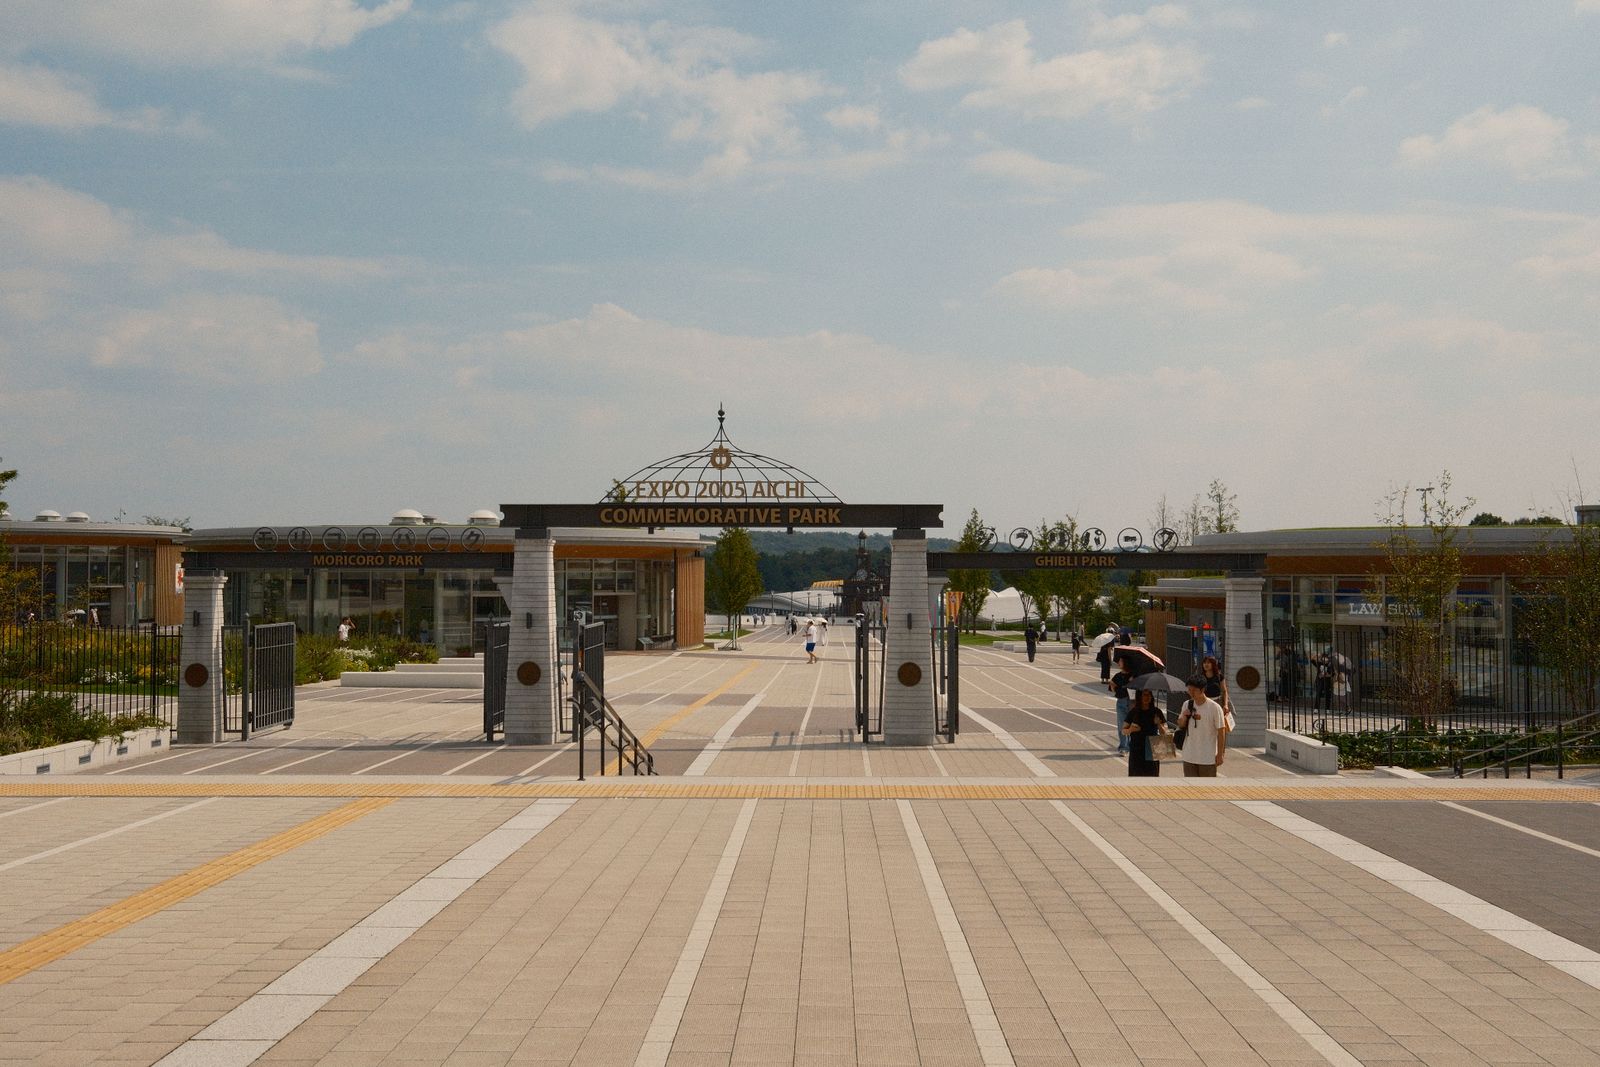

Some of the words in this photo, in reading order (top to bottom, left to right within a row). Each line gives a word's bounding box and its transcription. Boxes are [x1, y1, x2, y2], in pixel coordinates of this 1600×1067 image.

[636, 481, 690, 499] EXPO
[697, 481, 745, 499] 2005
[752, 481, 805, 499] AICHI
[600, 507, 782, 525] COMMEMORATIVE
[788, 507, 841, 525] PARK
[313, 555, 385, 566] MORICORO
[389, 555, 423, 566] PARK
[1035, 555, 1077, 566] GHIBLI
[1081, 555, 1117, 566] PARK
